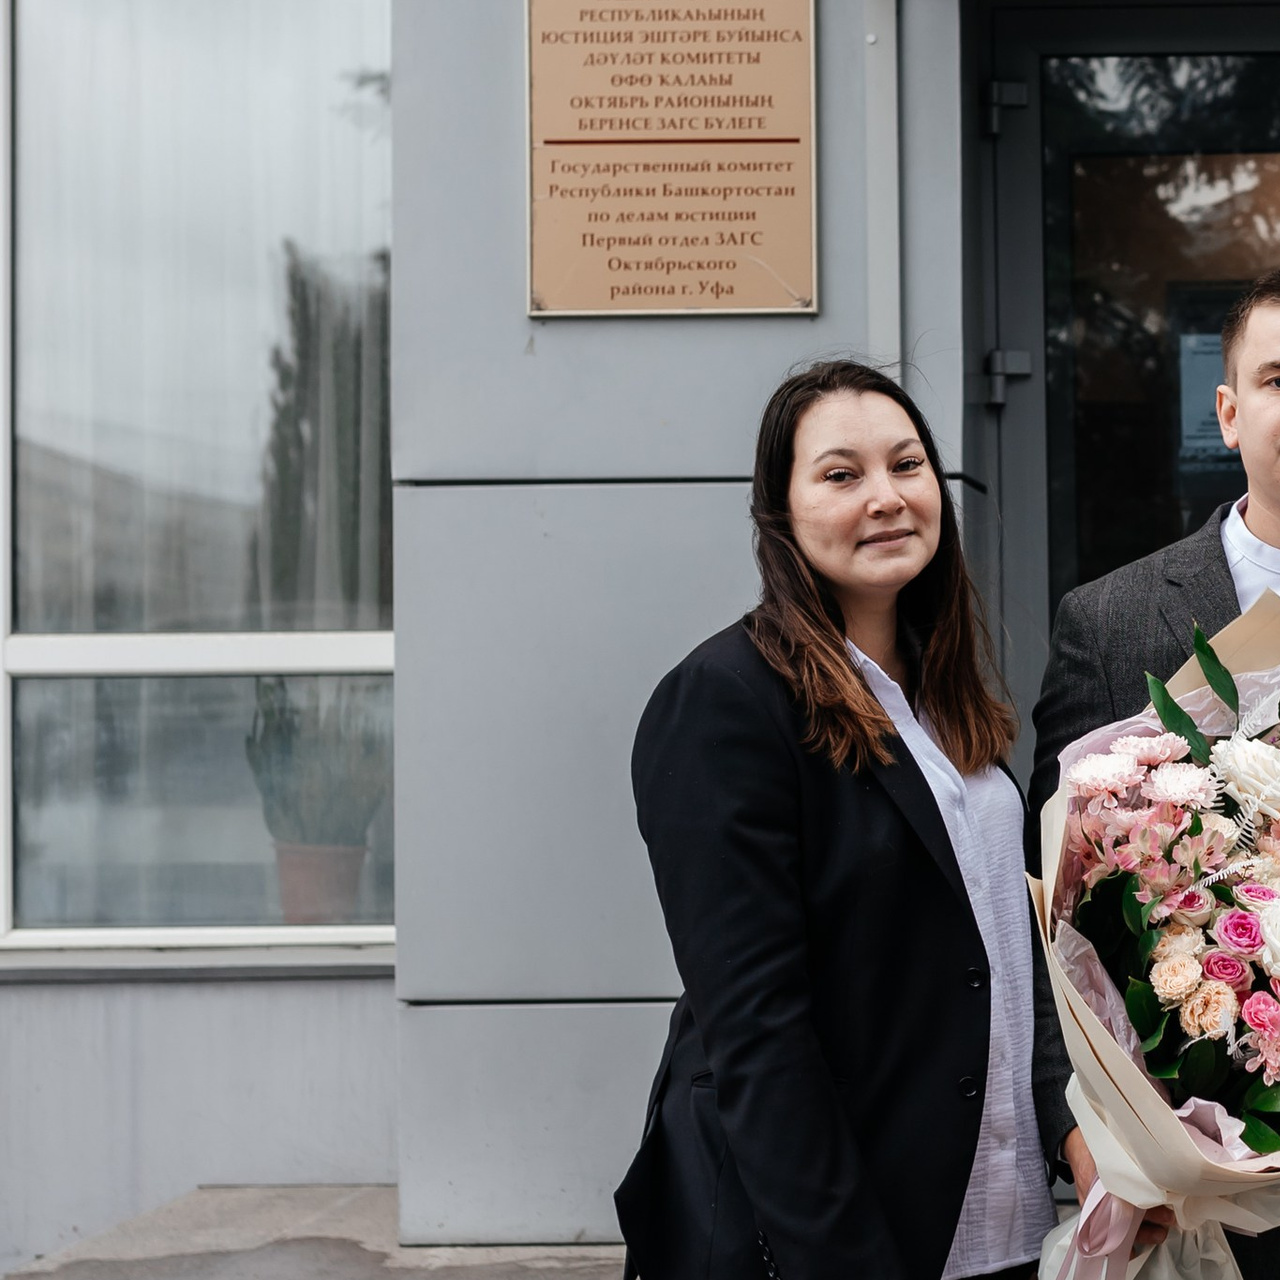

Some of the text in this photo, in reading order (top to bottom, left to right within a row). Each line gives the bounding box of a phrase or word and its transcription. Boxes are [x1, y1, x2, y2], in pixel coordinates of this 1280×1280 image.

[541, 30, 634, 46] ЮСТИЦИЯ
[716, 27, 803, 44] БУЙЫНСА
[660, 51, 761, 65] КОМИТЕТЫ
[569, 96, 649, 110] ОКТЯБРЬ
[578, 118, 653, 131] БЕРЕНСЕ
[656, 117, 701, 131] ЗАГС
[550, 159, 795, 177] Государственный комитет
[549, 183, 796, 203] Республики Башкортостан
[587, 210, 756, 224] по делам юстиции
[582, 231, 763, 251] Первый отдел ЗАГС
[607, 256, 737, 275] Октябрьского
[610, 280, 735, 300] района г. Уфа
